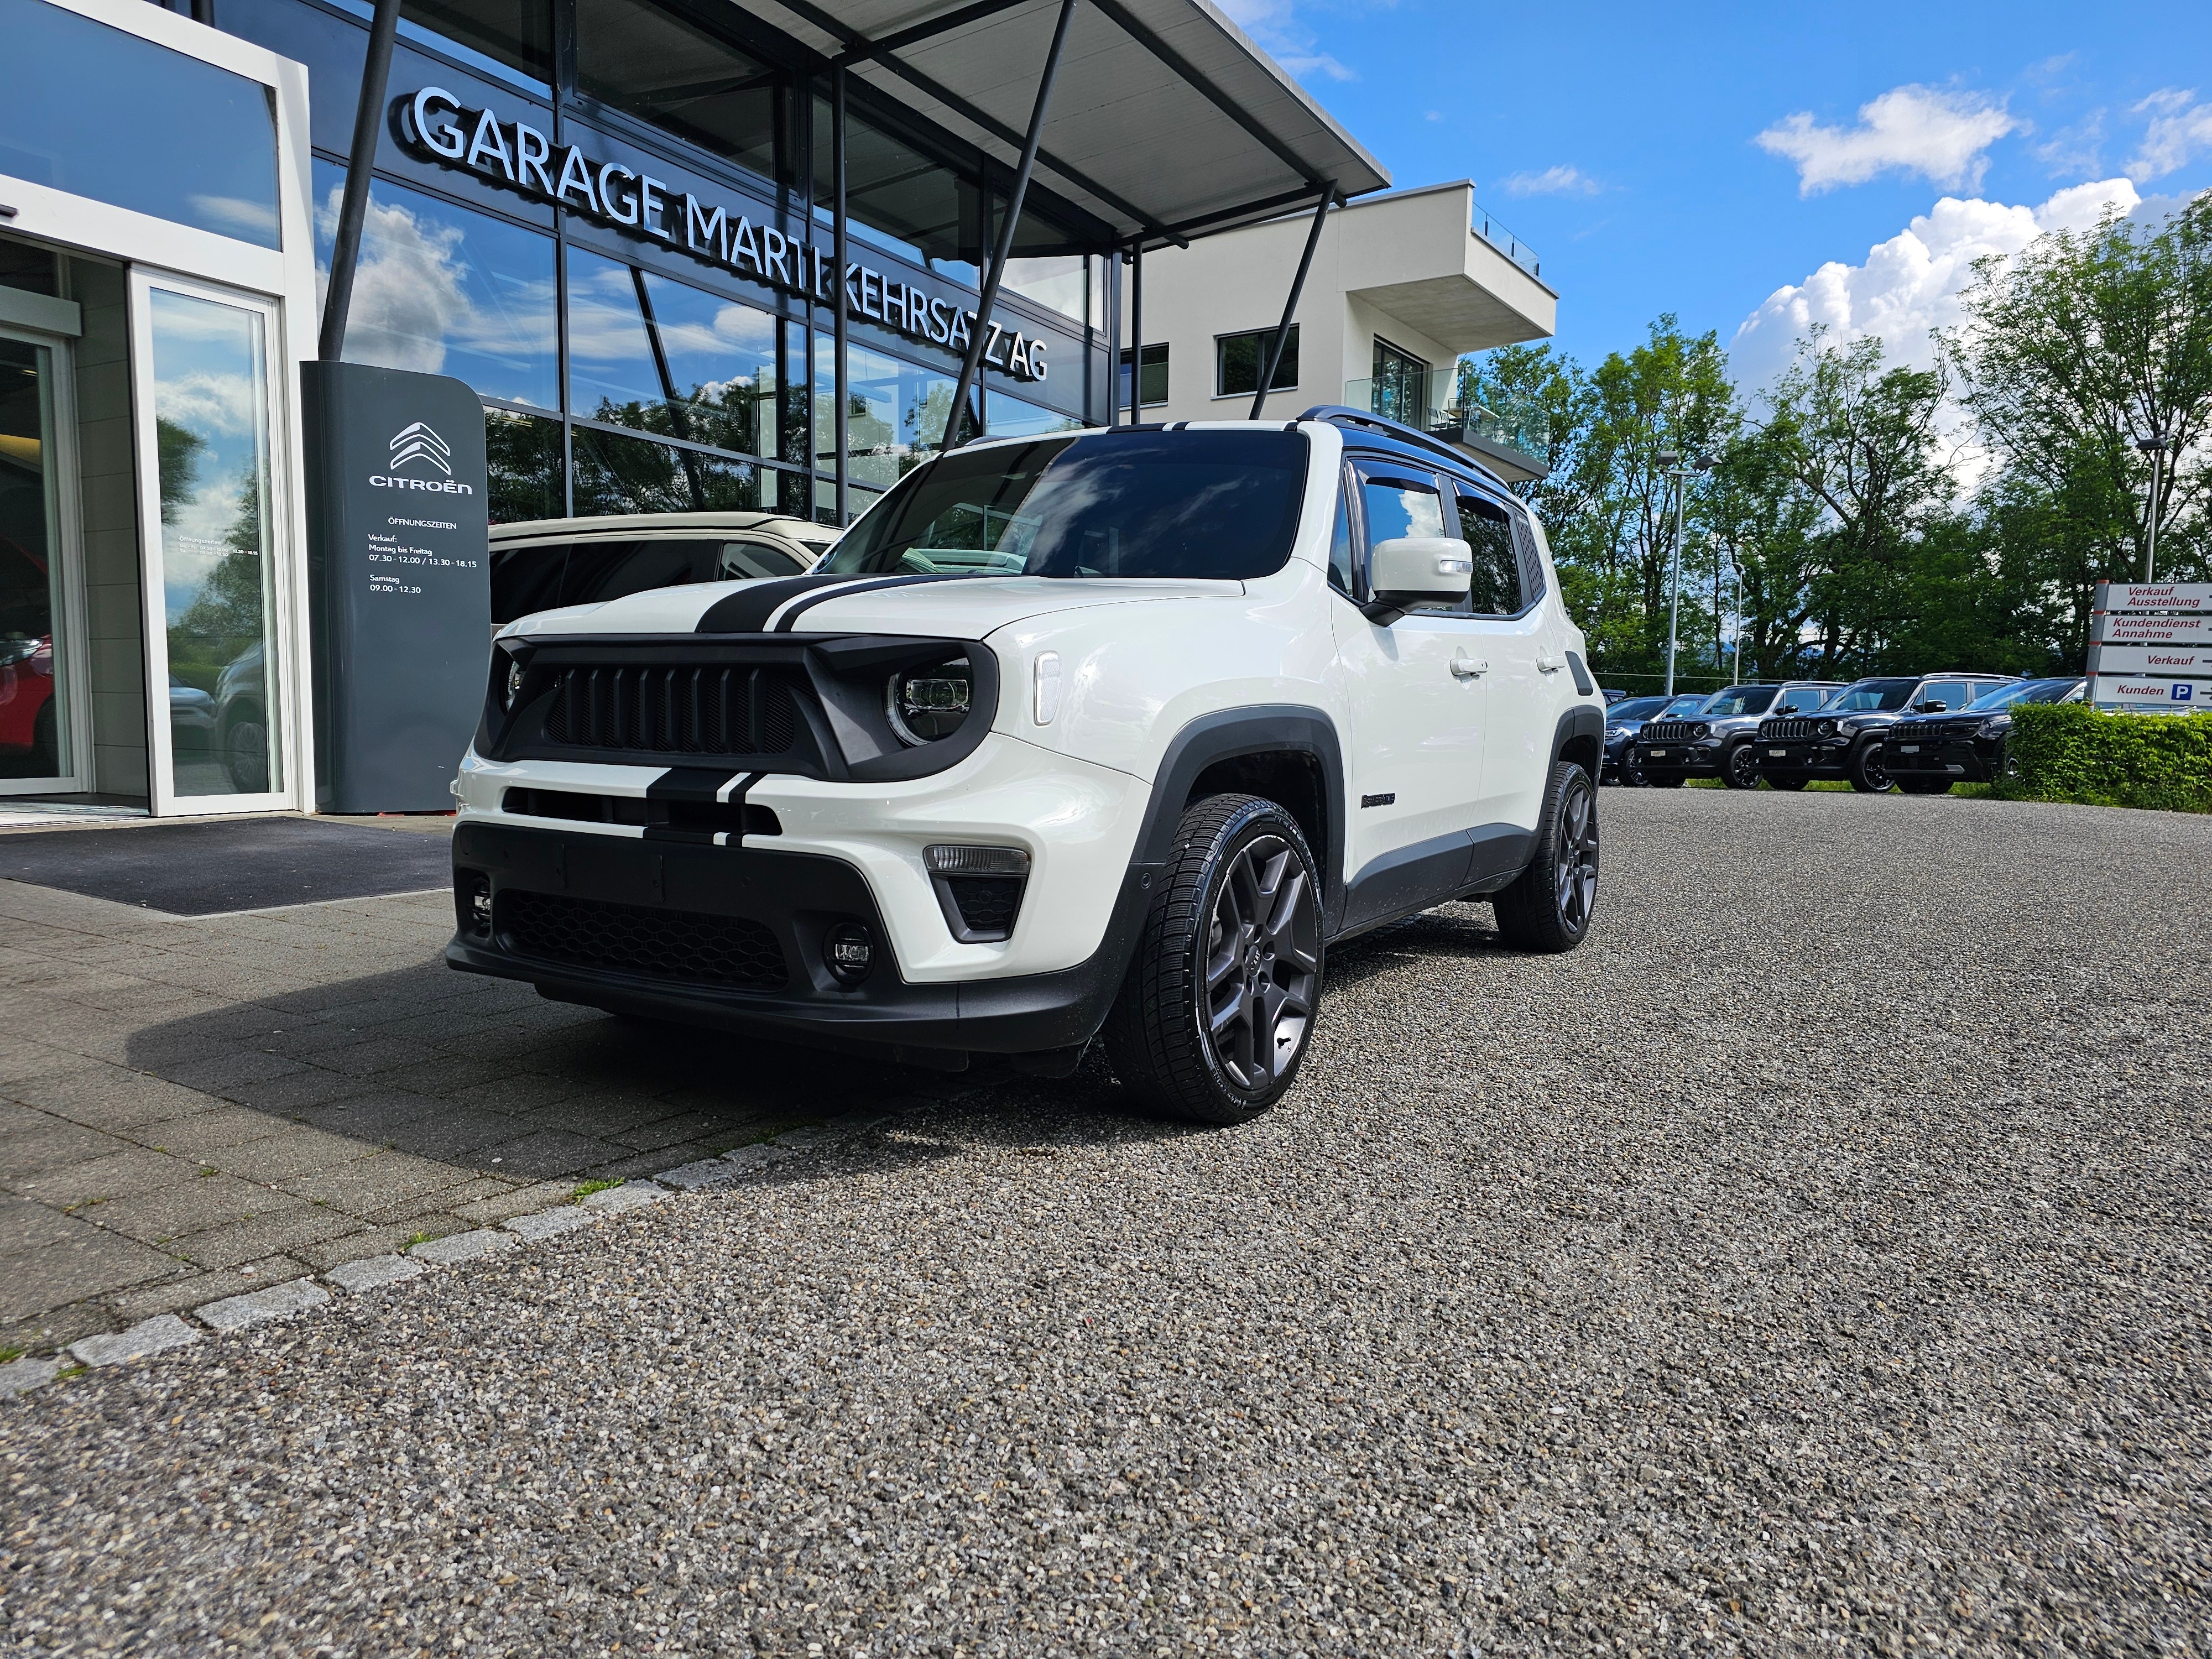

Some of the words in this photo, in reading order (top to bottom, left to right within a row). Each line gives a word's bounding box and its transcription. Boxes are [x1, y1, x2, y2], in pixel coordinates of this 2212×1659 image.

[414, 86, 669, 239] GARAGE
[685, 192, 821, 296] MARTI
[846, 262, 1003, 366] KEHRSAZ
[1009, 331, 1047, 381] AG
[388, 516, 457, 530] ÖFFNUNGSZEITEN
[179, 535, 221, 545] Öffnungszeiten
[368, 534, 398, 543] Verkauf:
[368, 544, 397, 554] Montag
[409, 546, 432, 557] Freitag
[456, 560, 477, 568] 18.15
[369, 574, 400, 584] Samstag
[370, 584, 393, 592] 09.00
[2128, 586, 2175, 596] Verkauf
[2127, 597, 2200, 608] Ausstellung
[2112, 618, 2201, 628] Kundendienst
[2112, 629, 2173, 639] Annahme
[2147, 655, 2195, 665] Verkauf
[2117, 685, 2164, 695] Kunden
